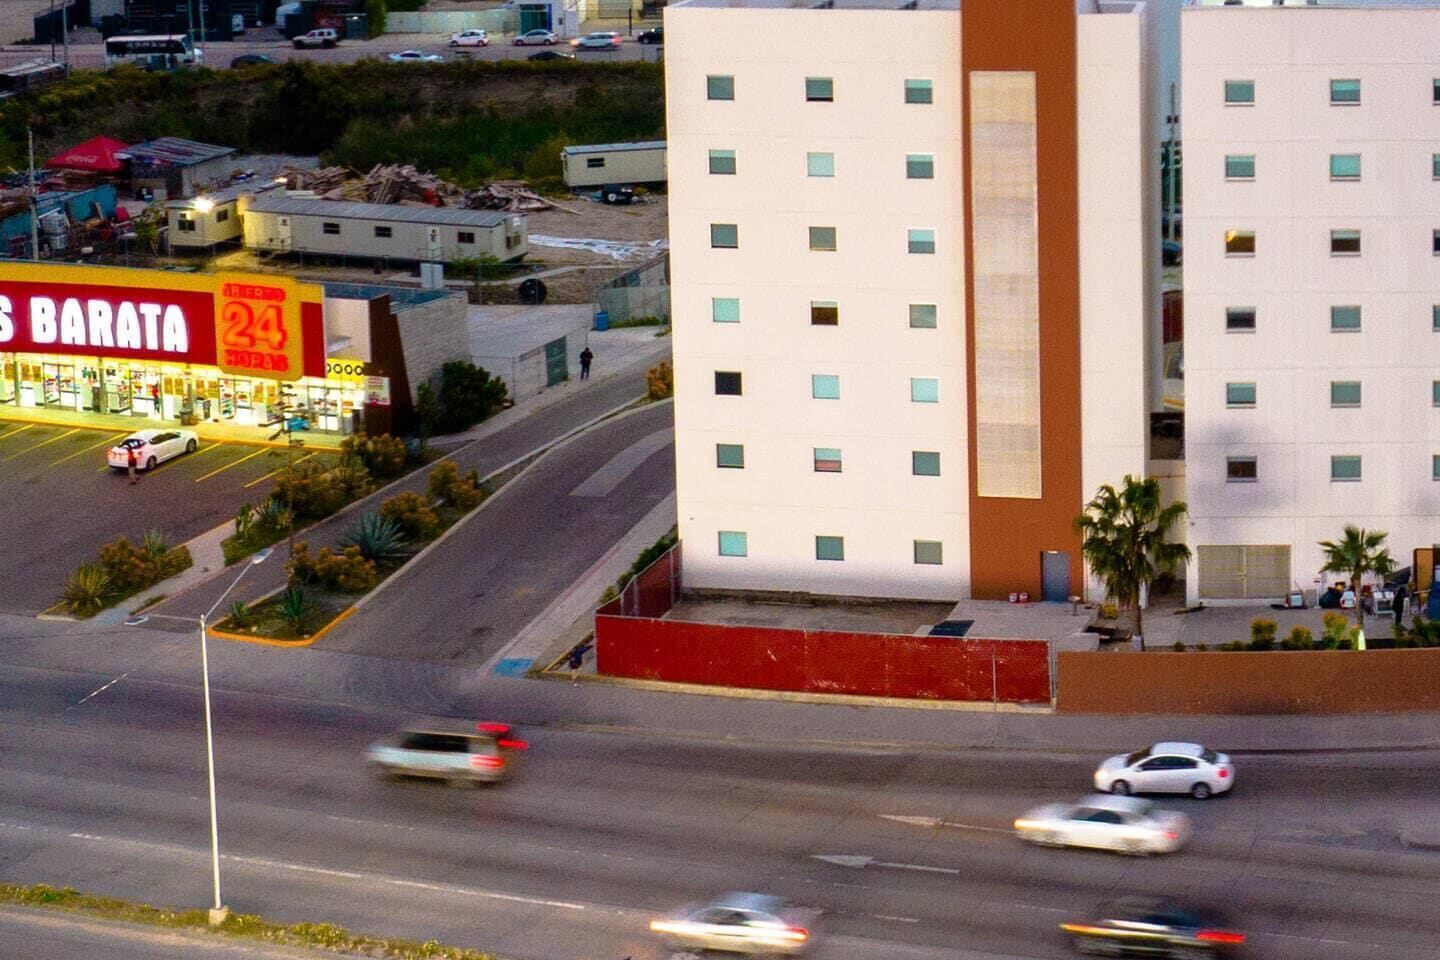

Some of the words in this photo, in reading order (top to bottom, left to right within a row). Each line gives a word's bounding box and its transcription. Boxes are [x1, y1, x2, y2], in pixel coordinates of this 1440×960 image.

[223, 283, 287, 302] ABIERTO
[30, 296, 189, 353] BARATA
[222, 301, 288, 351] 24
[224, 349, 289, 372] HORAS
